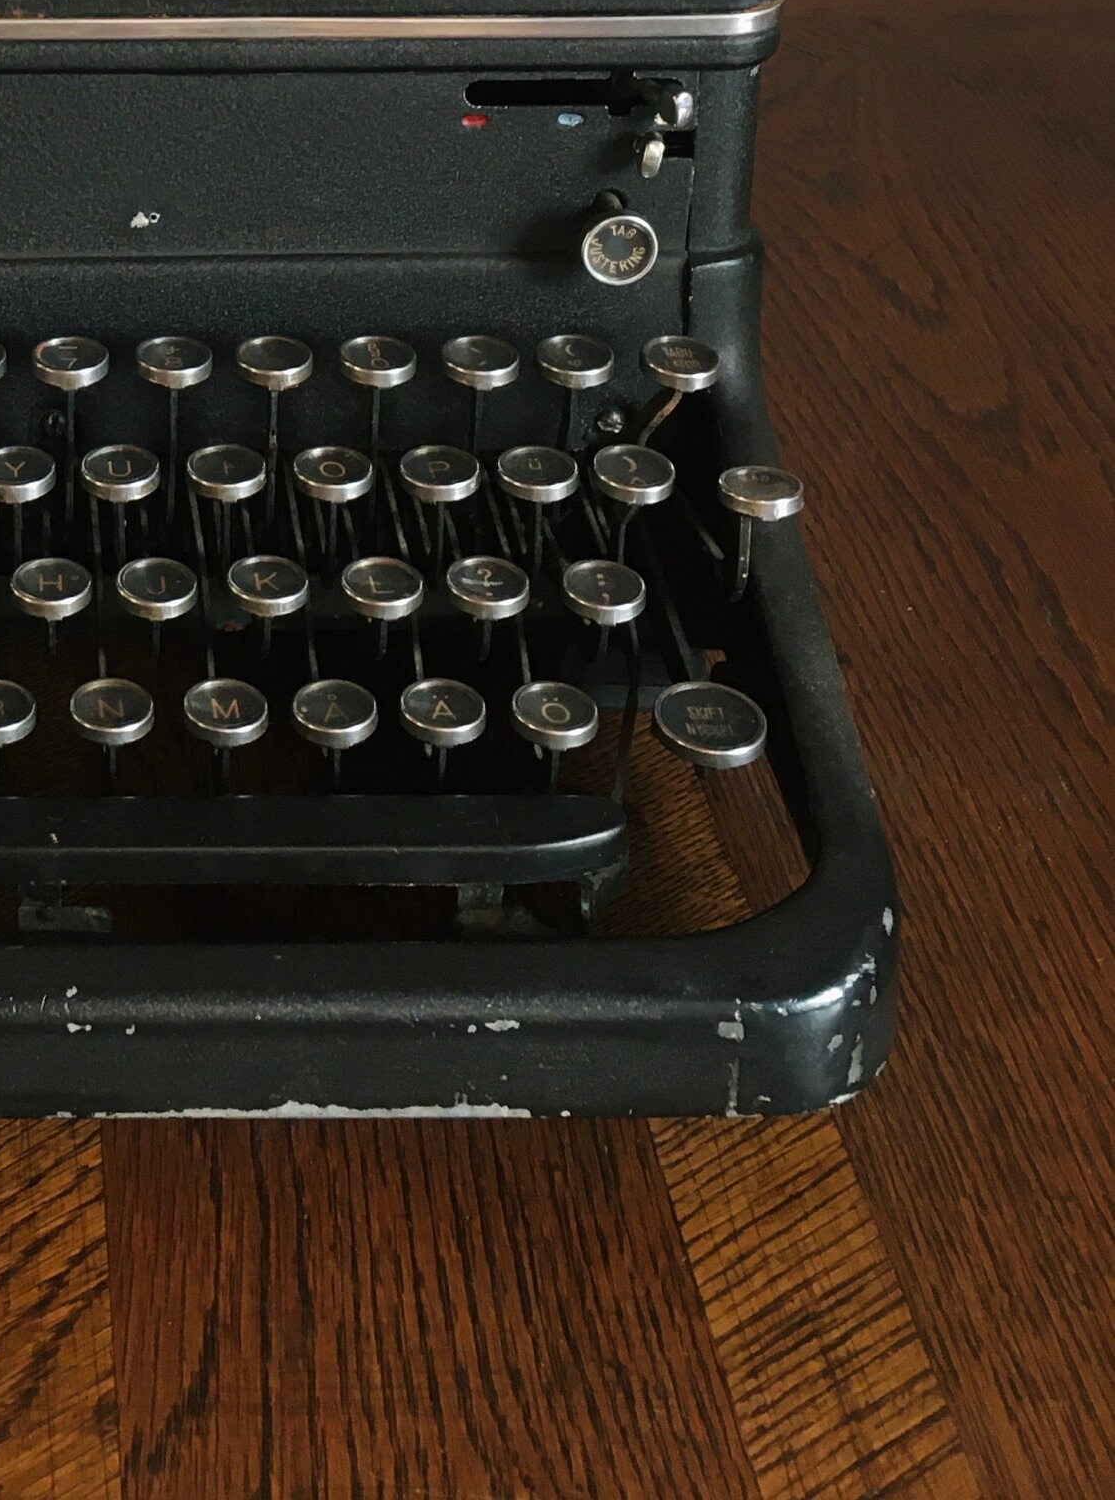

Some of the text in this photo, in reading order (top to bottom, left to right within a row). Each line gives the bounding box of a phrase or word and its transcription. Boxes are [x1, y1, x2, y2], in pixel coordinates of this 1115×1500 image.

[610, 225, 637, 239] TAB
[4, 461, 26, 478] Y
[107, 460, 132, 477] U
[319, 461, 346, 478] O
[429, 461, 450, 478] P
[38, 574, 63, 593] H
[146, 575, 166, 595] J
[253, 571, 279, 592] K
[369, 575, 396, 595] L
[97, 698, 125, 719] N
[210, 697, 241, 719] M
[323, 694, 349, 724] Å
[431, 693, 458, 720] Ä
[541, 696, 571, 724] Ö
[686, 706, 725, 720] SKIFT
